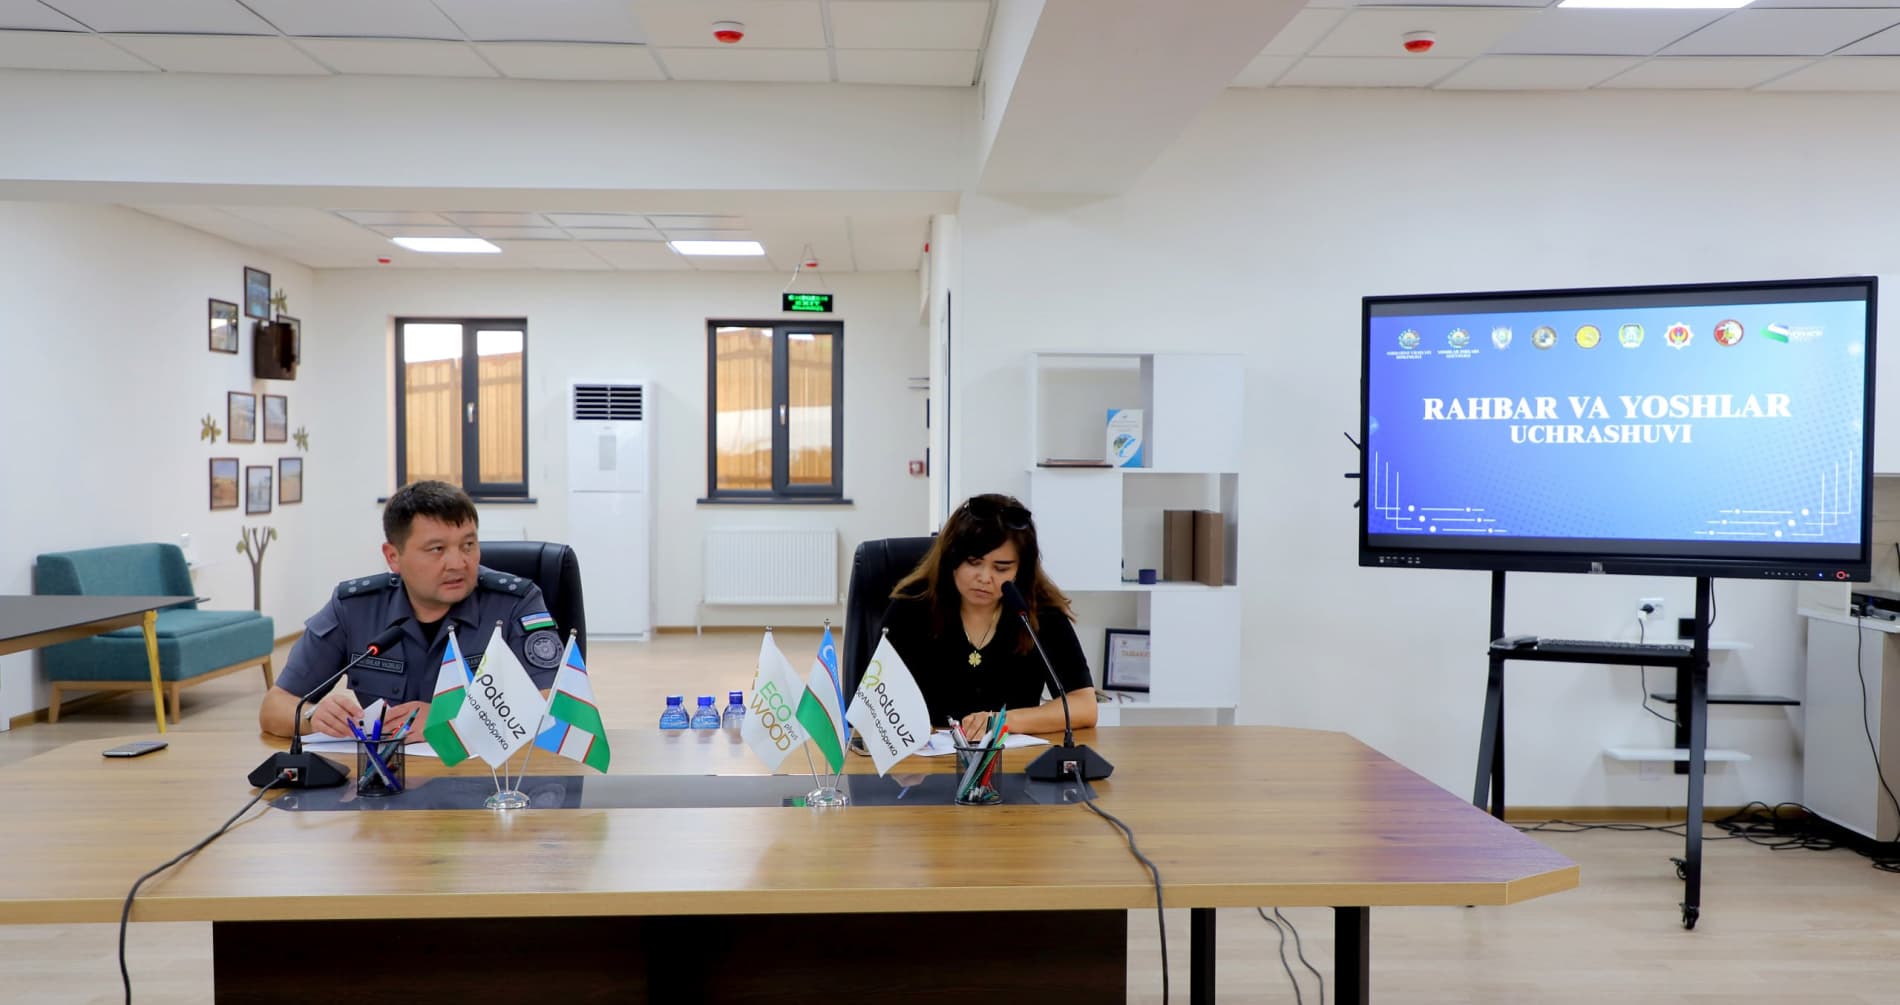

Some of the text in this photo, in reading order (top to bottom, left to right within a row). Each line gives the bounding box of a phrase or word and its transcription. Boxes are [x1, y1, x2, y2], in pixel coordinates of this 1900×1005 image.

[1423, 393, 1792, 420] RAHBAR VA YOSHLAR
[1510, 424, 1693, 444] UCHRASHUVI
[476, 674, 526, 740] patio.uz
[760, 681, 792, 722] ECO
[874, 682, 916, 747] patio.uz
[479, 710, 509, 751] фабрика
[751, 694, 791, 751] WOOD
[875, 718, 898, 757] фабрика
